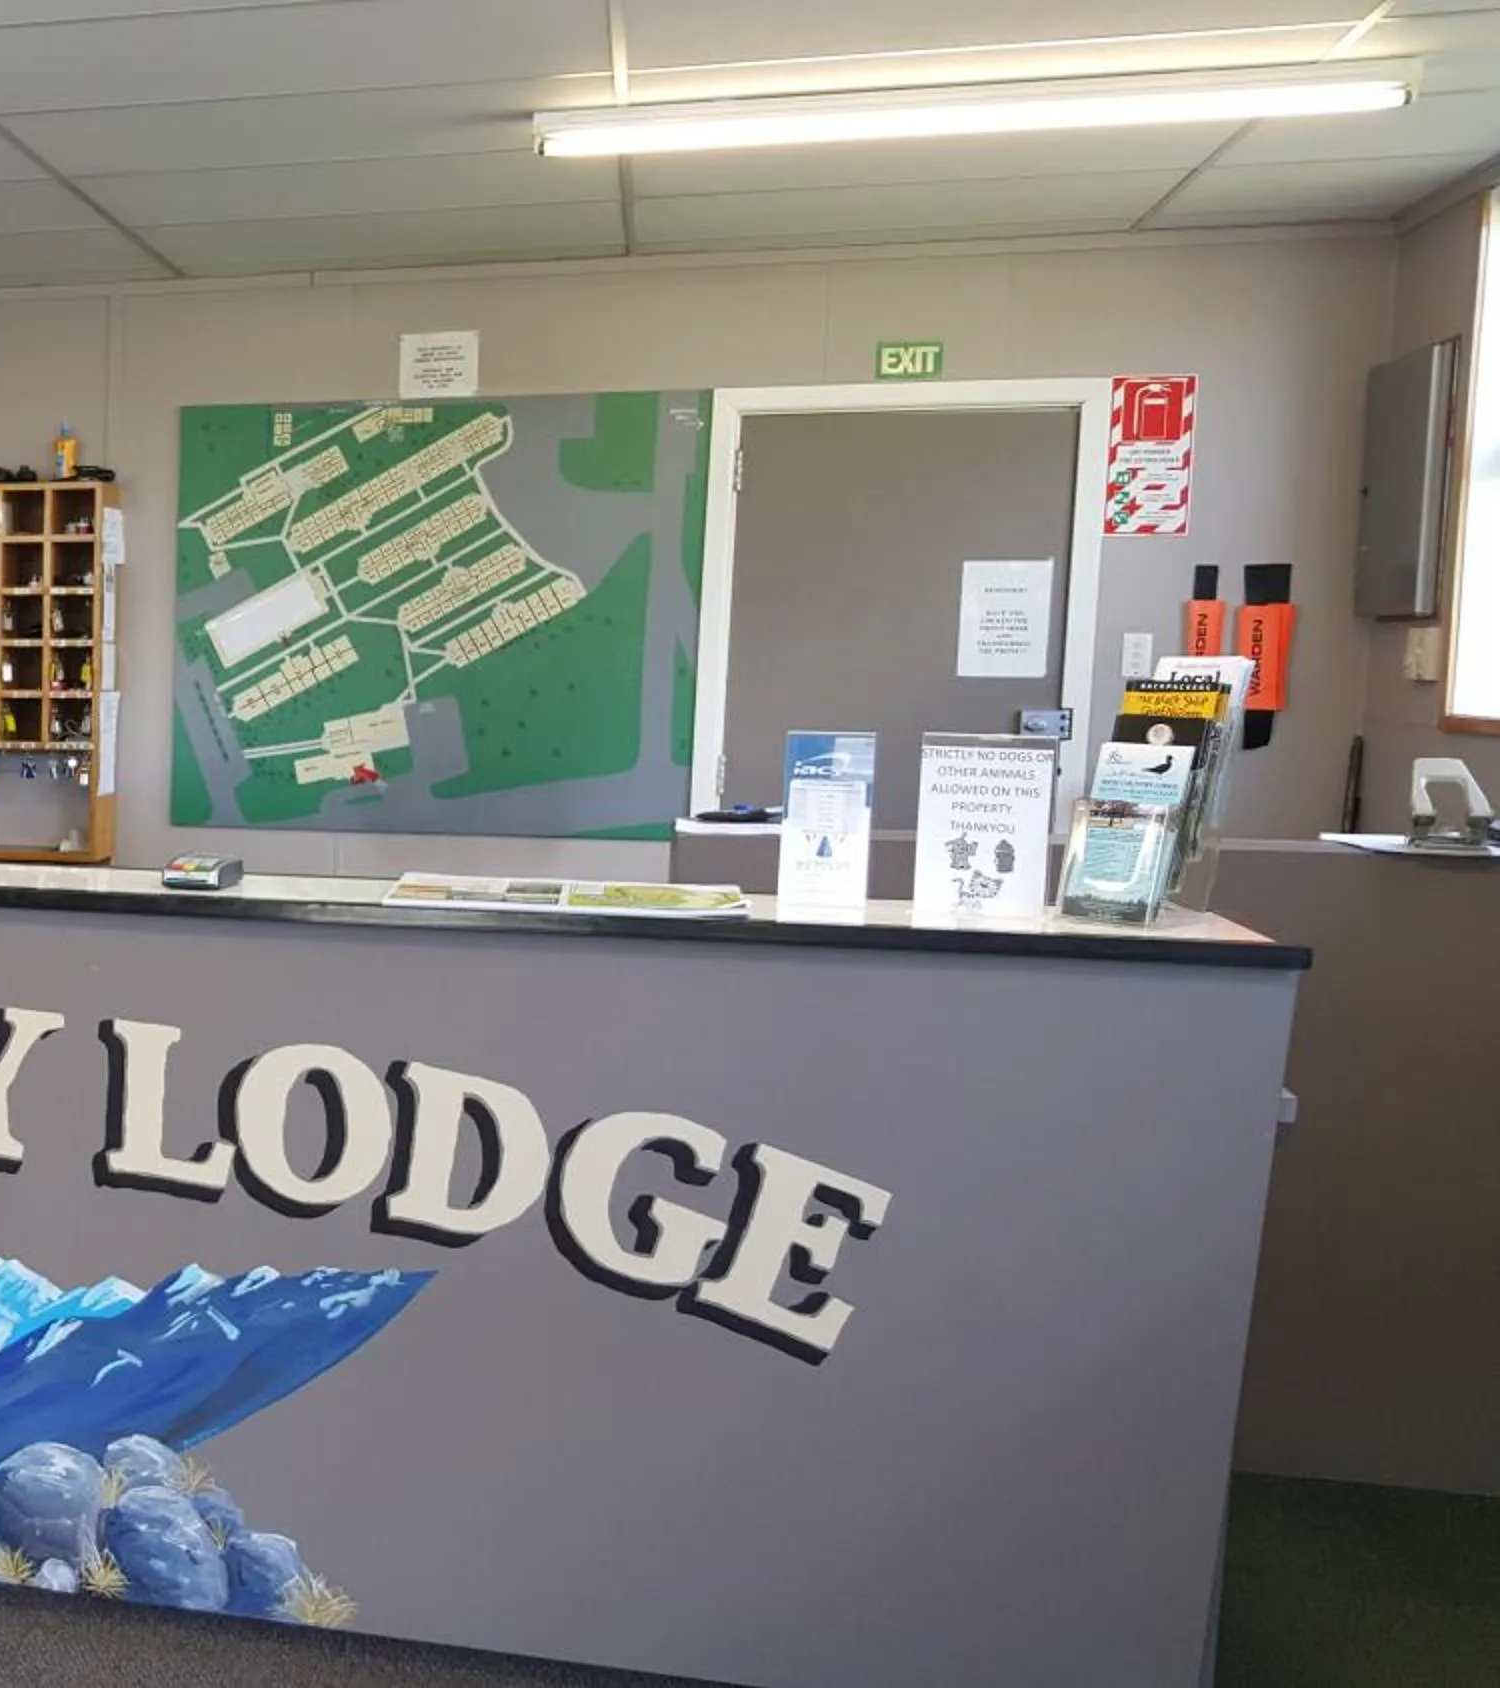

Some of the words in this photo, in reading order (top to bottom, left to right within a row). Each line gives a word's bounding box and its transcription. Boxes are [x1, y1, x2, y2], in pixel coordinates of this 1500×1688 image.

[881, 346, 940, 374] EXIT
[1195, 613, 1208, 656] DEN
[1170, 670, 1220, 685] Local
[923, 748, 973, 760] STRICTLY
[977, 750, 996, 761] NO
[999, 751, 1033, 762] DOGS
[937, 765, 977, 777] OTHER
[980, 767, 1037, 780] ANIMALS
[930, 783, 989, 797] ALLOWED
[991, 785, 1011, 797] ON
[1014, 786, 1041, 799] THIS
[94, 1017, 894, 1367] LODGE
